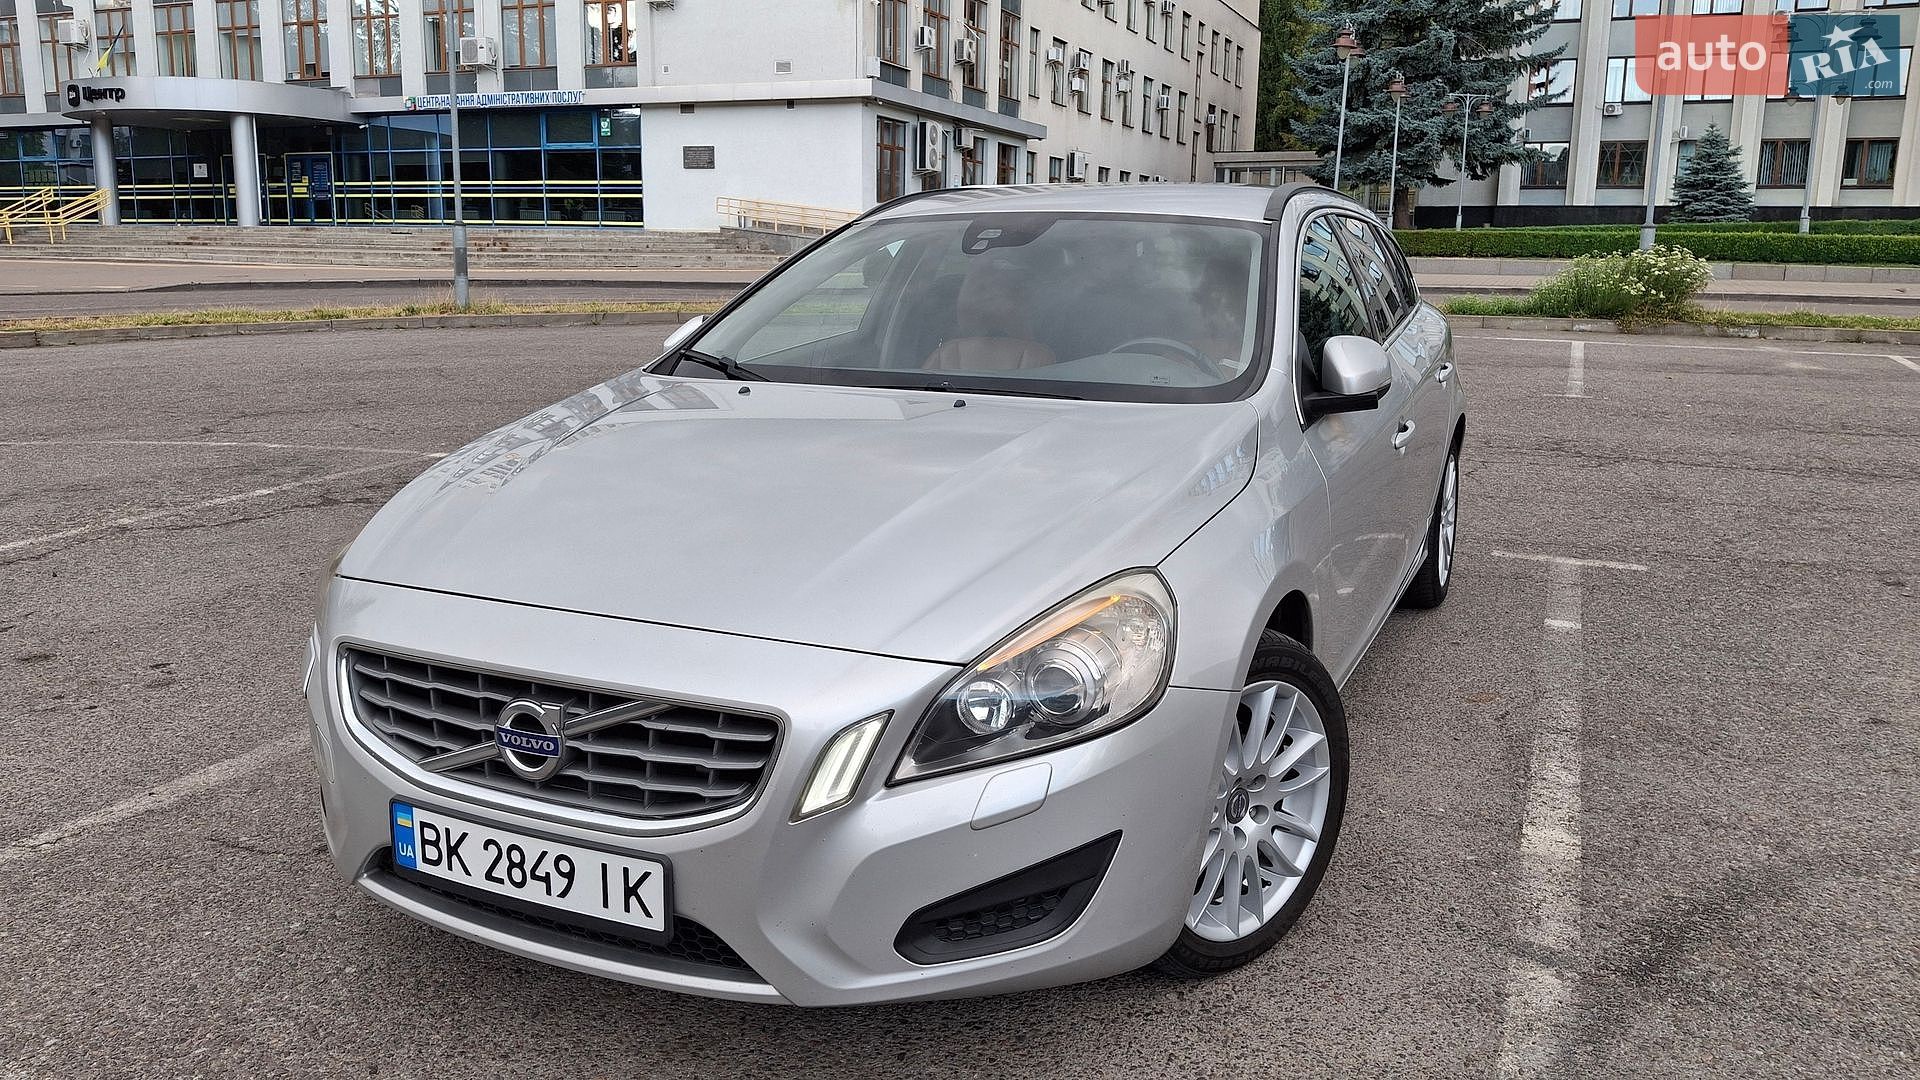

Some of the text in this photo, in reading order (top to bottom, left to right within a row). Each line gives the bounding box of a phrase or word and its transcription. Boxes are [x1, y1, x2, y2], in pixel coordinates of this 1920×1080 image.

[82, 87, 126, 103] Центр
[417, 90, 583, 108] ЦЕНТР НААННЯ АДМІНІСТРАТИВНИХ ПОСЛУГ
[499, 732, 555, 751] VOLVO
[399, 844, 415, 858] UA
[420, 821, 654, 920] BK 2849 IK
